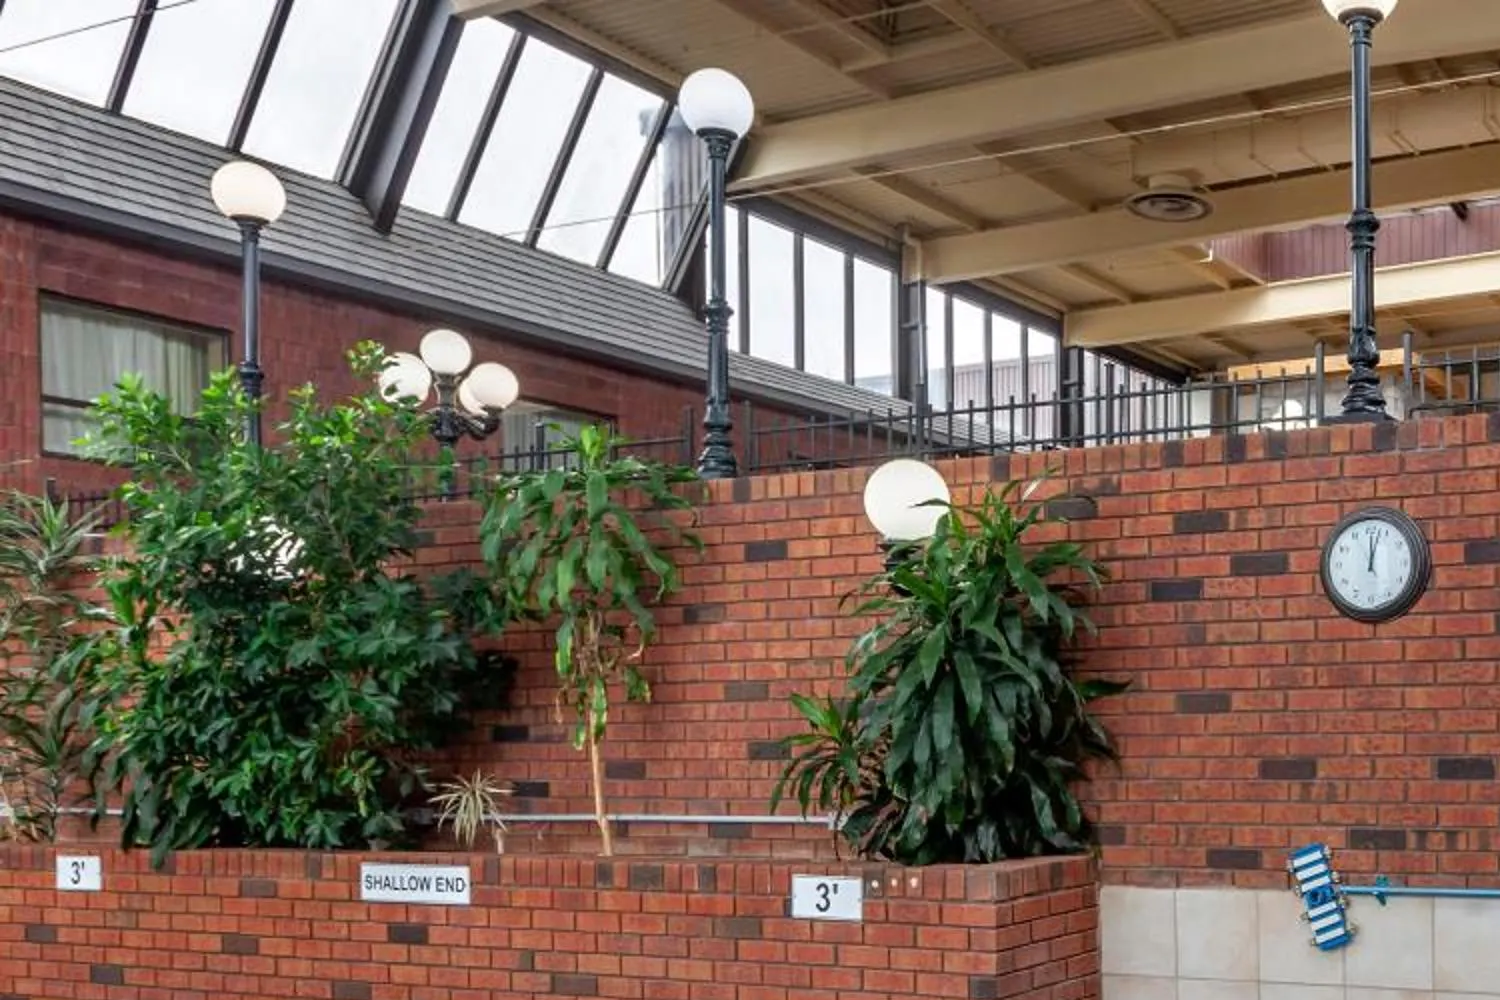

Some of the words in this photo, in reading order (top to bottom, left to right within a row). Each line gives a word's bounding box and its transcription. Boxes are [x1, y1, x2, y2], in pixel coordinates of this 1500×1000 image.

[71, 860, 85, 885] 3'
[364, 874, 432, 892] SHALLOW
[435, 876, 467, 893] END
[815, 882, 839, 912] 3'
